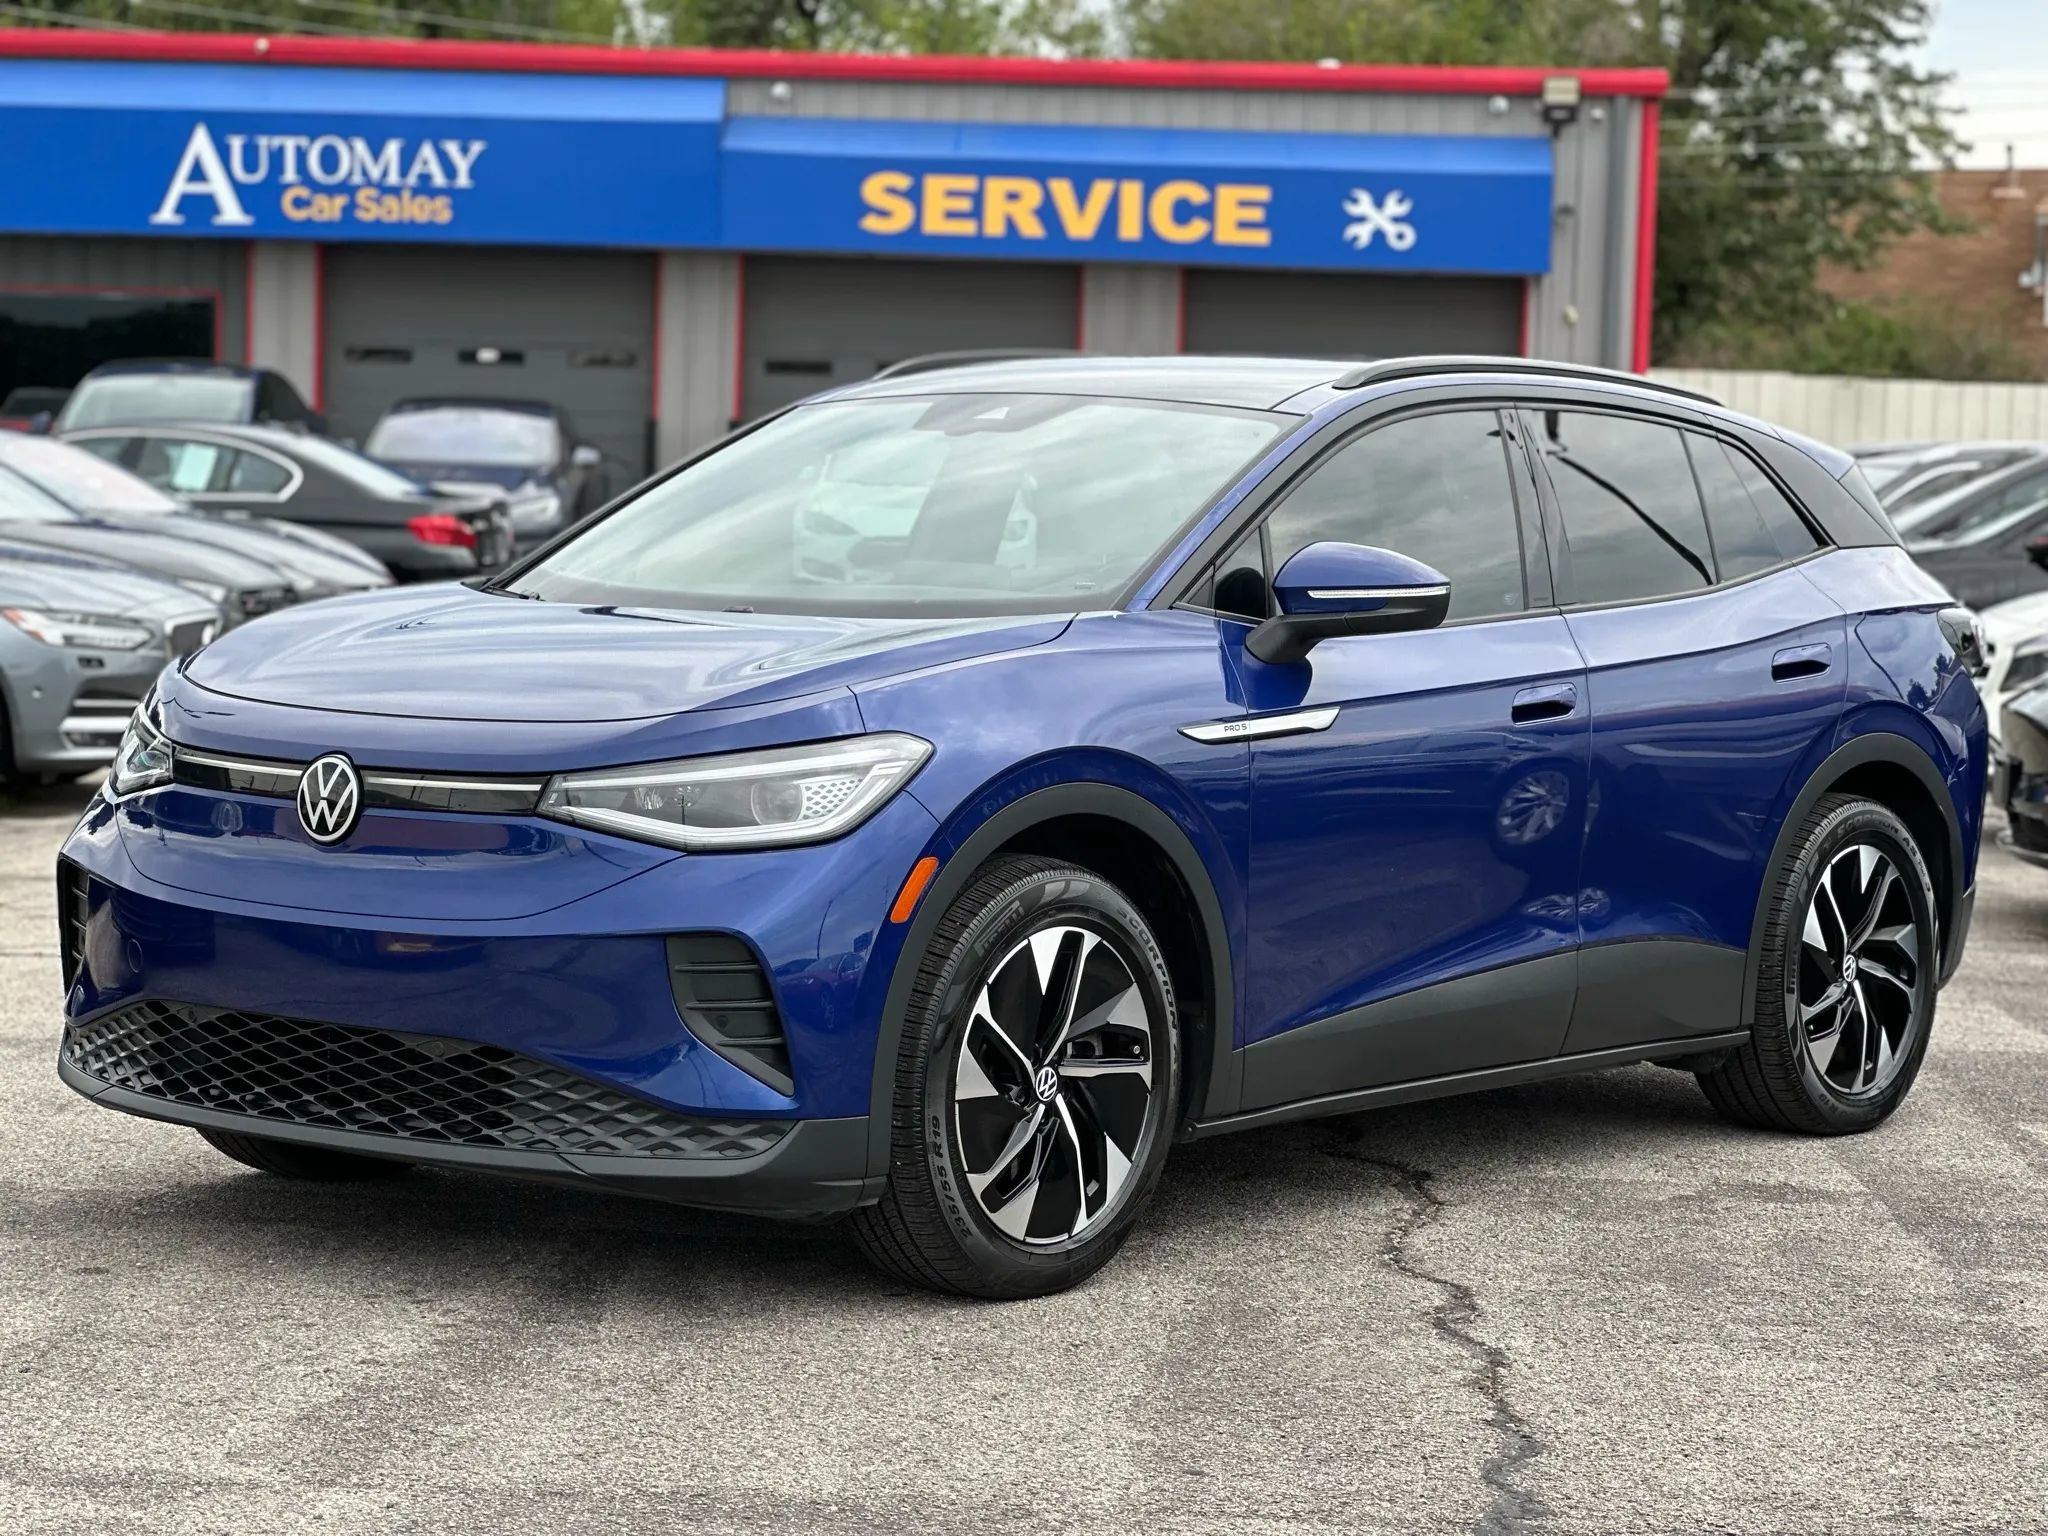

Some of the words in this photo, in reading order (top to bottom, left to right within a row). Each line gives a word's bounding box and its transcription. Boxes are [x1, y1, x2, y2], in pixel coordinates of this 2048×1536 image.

[149, 122, 486, 226] AUTOMAY
[281, 185, 350, 222] Car
[354, 186, 453, 224] Sales
[859, 171, 1272, 247] SERVICE
[1223, 724, 1240, 733] PRO
[1116, 907, 1178, 1031] SCORPION
